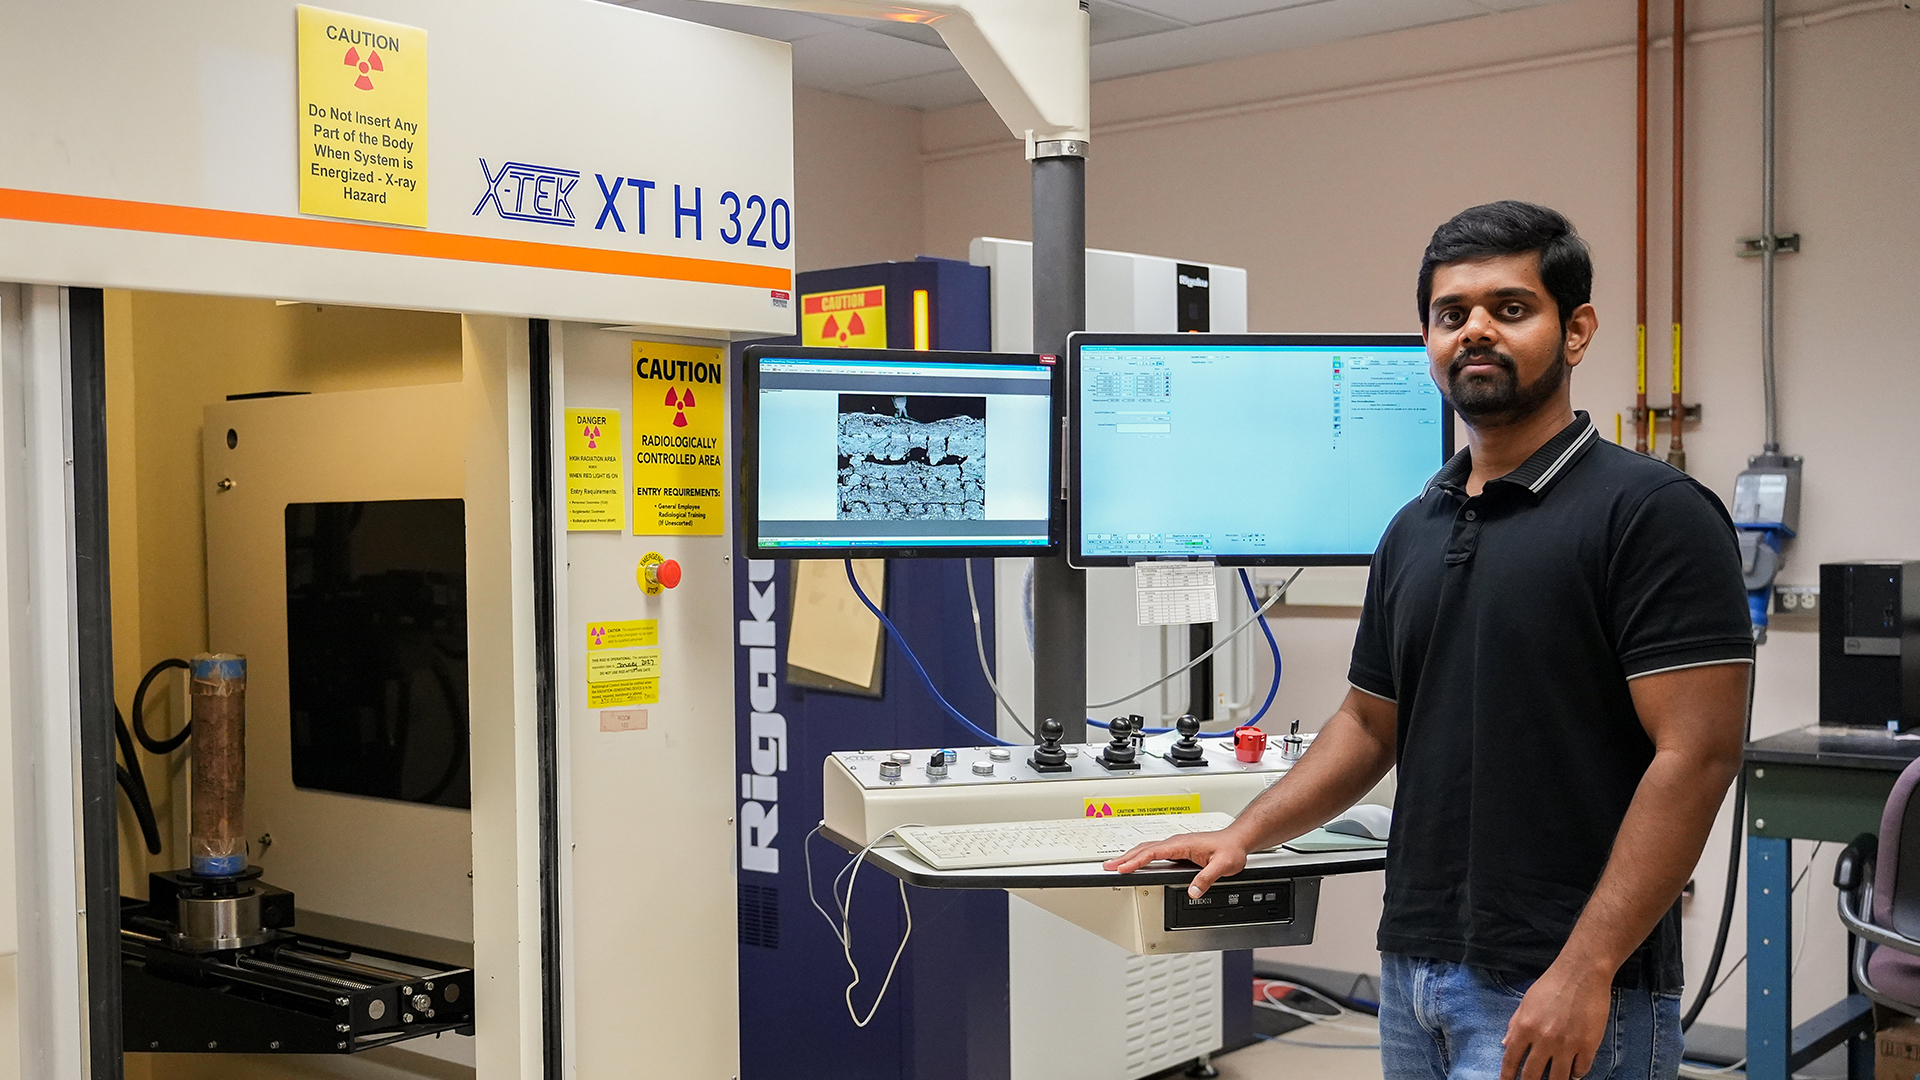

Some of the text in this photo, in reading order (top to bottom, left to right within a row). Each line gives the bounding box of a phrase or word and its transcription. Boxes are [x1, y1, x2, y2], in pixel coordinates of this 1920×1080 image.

[326, 25, 400, 52] CAUTION
[308, 103, 418, 135] Do Not Insert Any
[314, 124, 414, 154] Part of the Body
[314, 144, 413, 170] When System is
[311, 163, 374, 183] Energized
[385, 173, 417, 191] X-ray
[344, 187, 387, 204] Hazard
[471, 157, 791, 251] X-TEK XT H 320
[821, 292, 865, 311] CAUTION
[636, 357, 721, 384] CAUTION
[577, 416, 606, 425] DANGER
[642, 435, 717, 449] RADIOLOGICALLY
[637, 452, 721, 466] CONTROLLED AREA
[637, 487, 721, 497] ENTRY REQUIREMENTS:
[640, 553, 664, 567] EMERGENC
